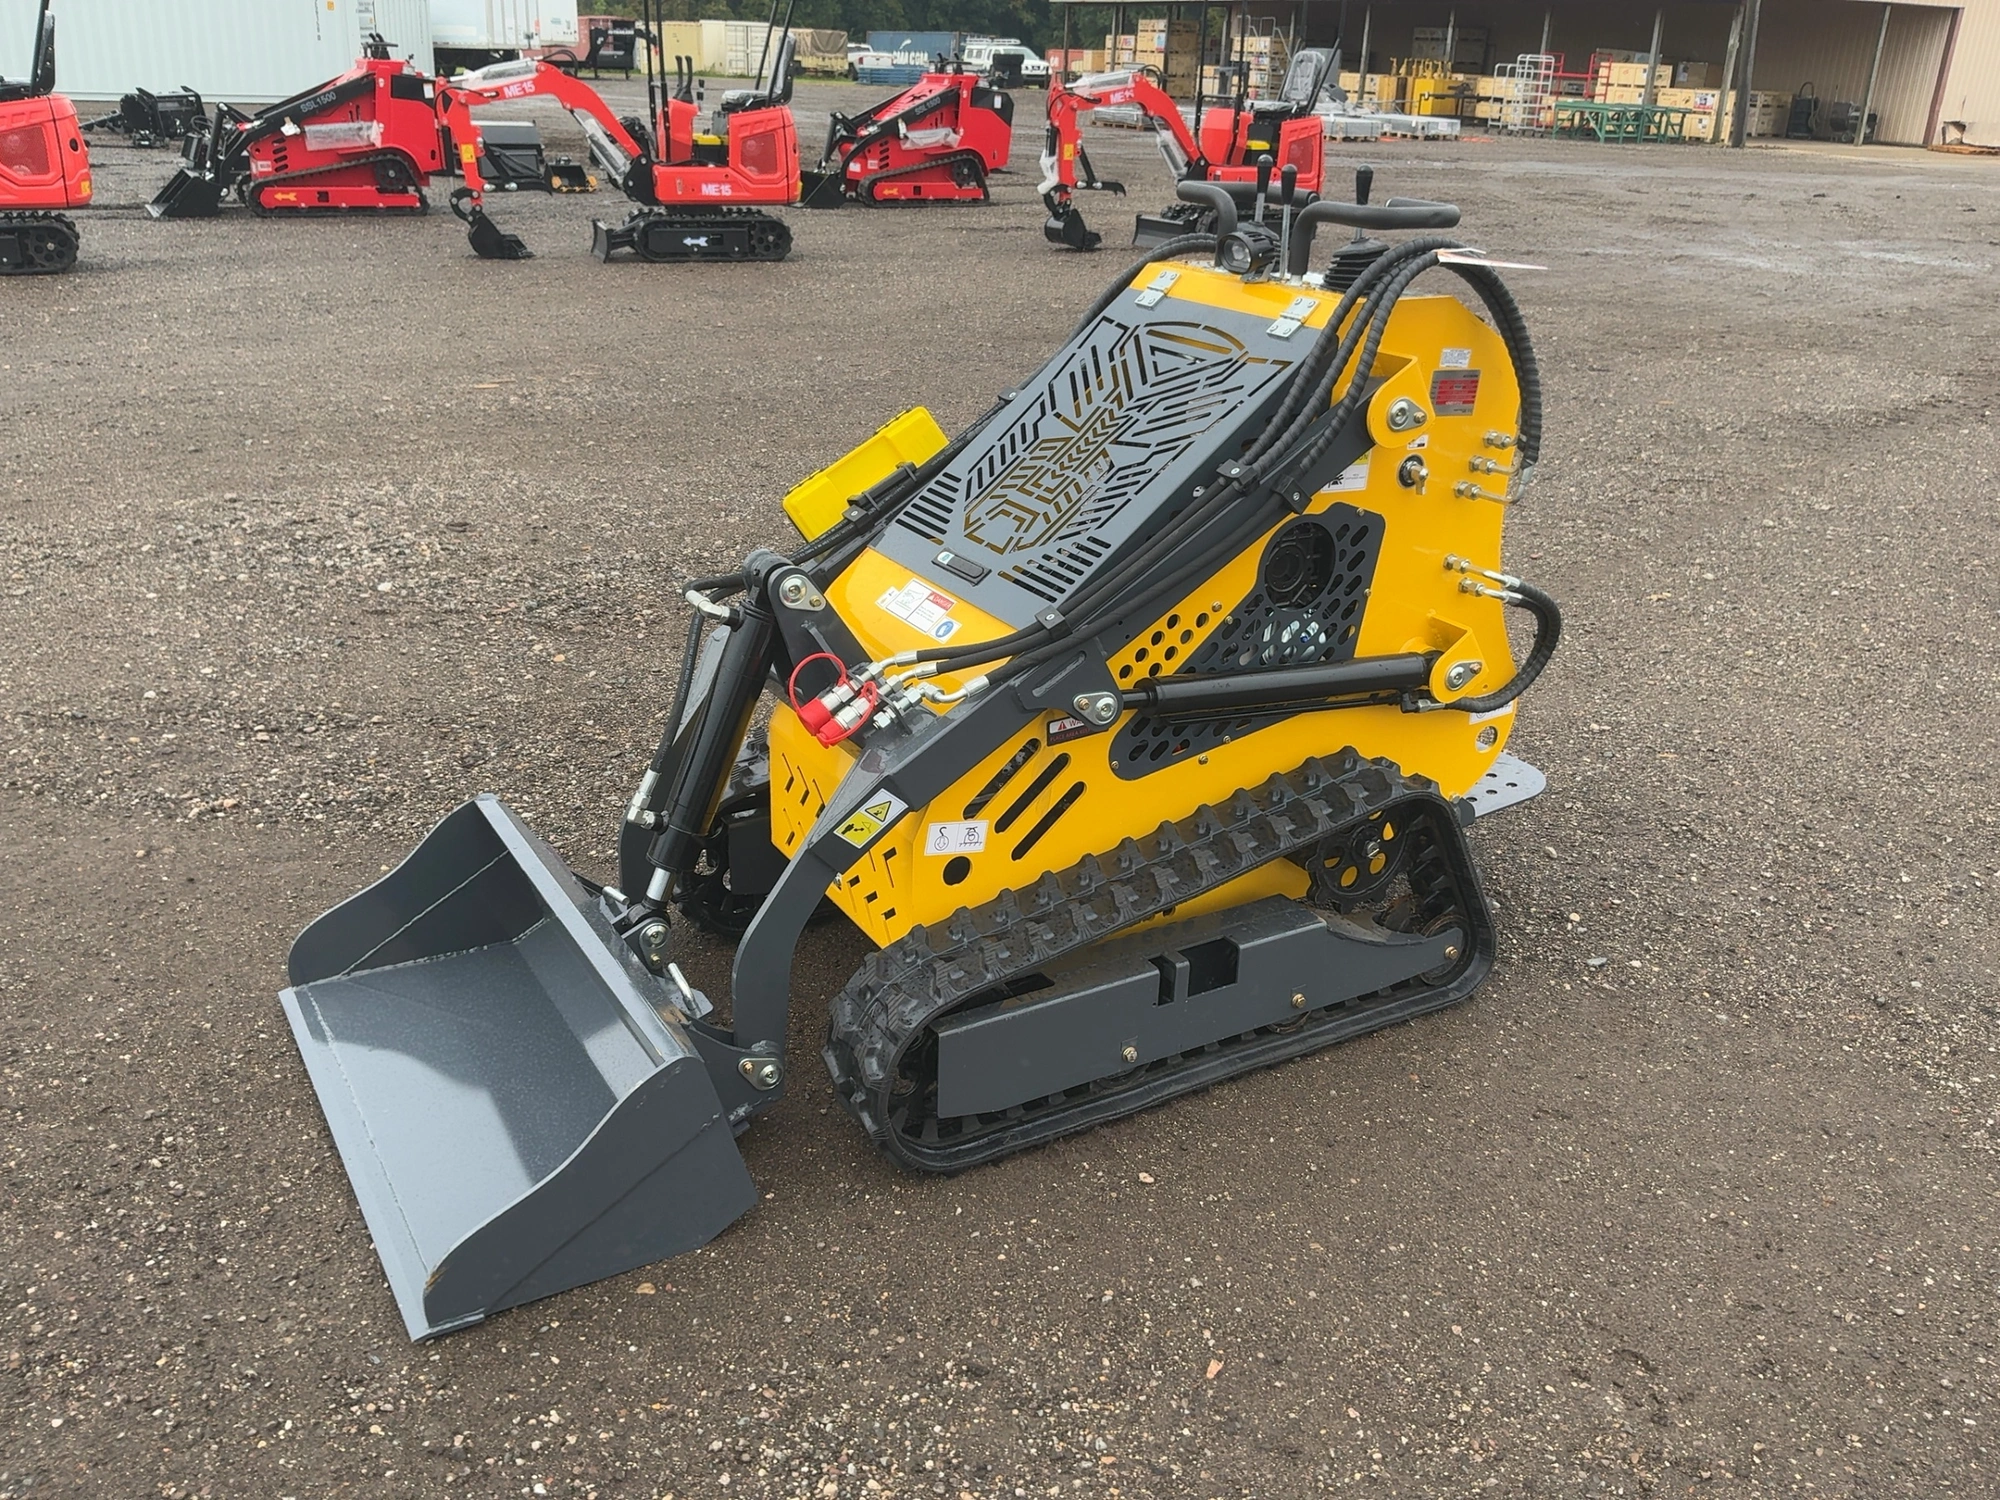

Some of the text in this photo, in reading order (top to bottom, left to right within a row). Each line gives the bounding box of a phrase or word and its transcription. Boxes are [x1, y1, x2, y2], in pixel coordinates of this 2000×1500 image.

[503, 80, 536, 98] ME15
[300, 91, 337, 113] SSL1500
[914, 96, 941, 115] SSL1500
[701, 182, 732, 196] ME15
